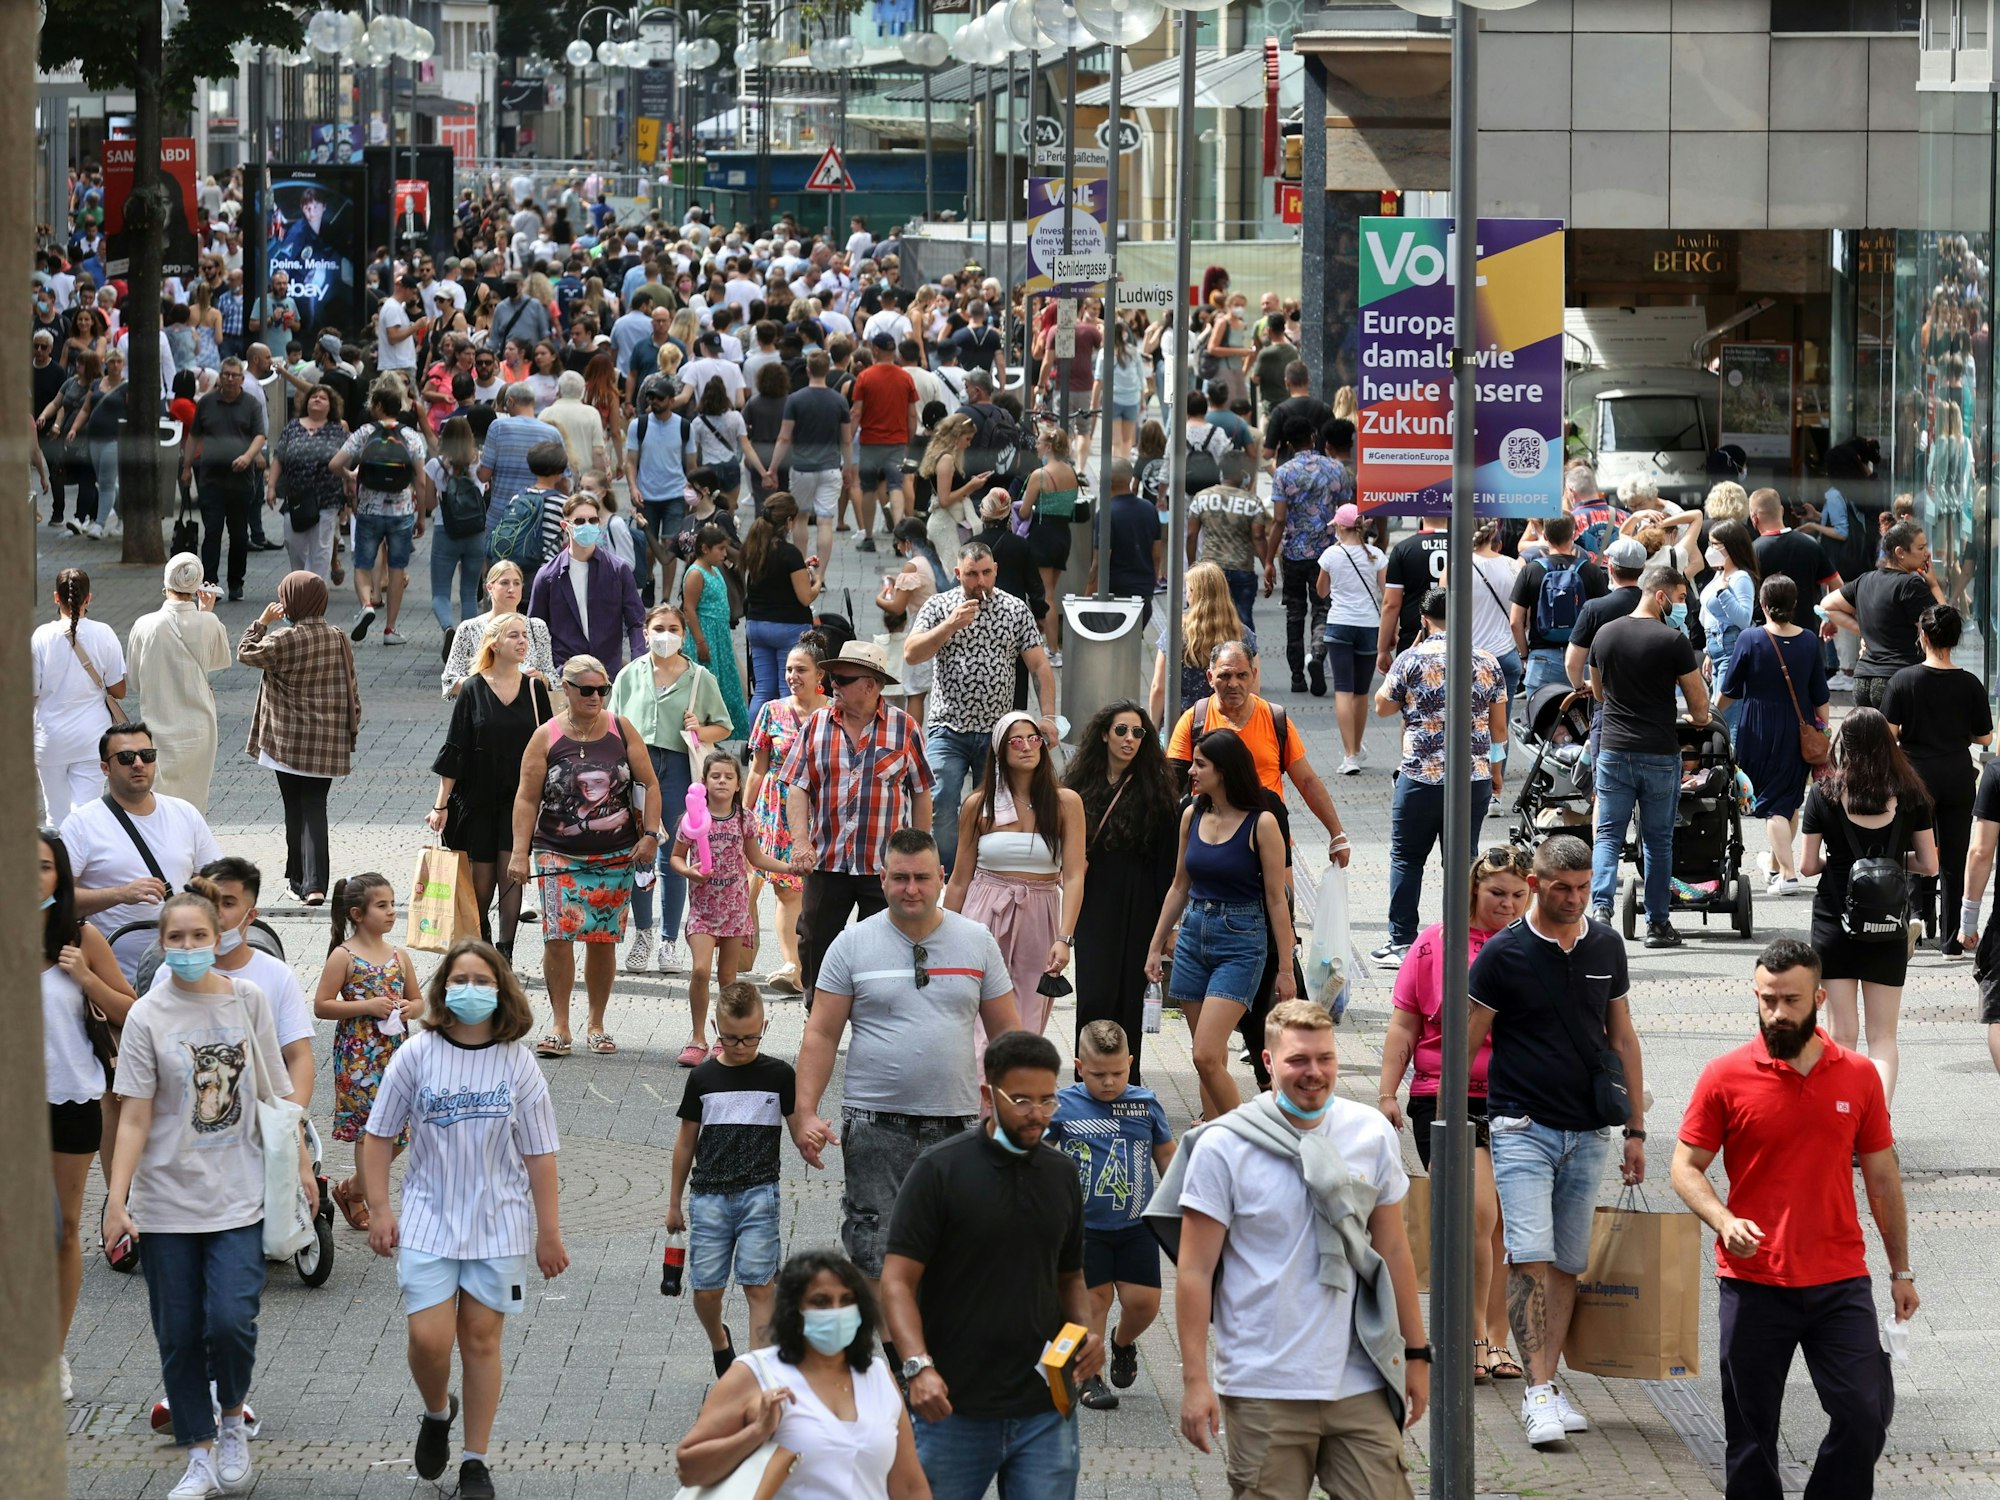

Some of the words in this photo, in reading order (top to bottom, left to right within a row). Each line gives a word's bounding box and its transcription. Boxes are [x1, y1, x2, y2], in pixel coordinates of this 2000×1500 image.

[321, 127, 352, 142] Vlt
[641, 125, 649, 134] U
[107, 150, 136, 163] SAN
[1046, 150, 1106, 164] Perlegäßchen
[1040, 227, 1088, 236] Investren
[1090, 227, 1097, 236] in
[1036, 238, 1056, 246] eine
[1056, 238, 1101, 247] Wschaft
[1042, 248, 1055, 256] mit
[162, 264, 181, 274] SPD
[270, 259, 303, 270] Deins.
[305, 259, 340, 270] Meins.
[1057, 261, 1107, 280] Schildergasse
[1118, 286, 1174, 306] Ludwigs
[1363, 311, 1455, 340] Europa
[1362, 375, 1441, 402] heute
[1450, 383, 1544, 403] nsere
[1361, 409, 1479, 436] Zukunf.
[1368, 451, 1450, 462] #GenerationEuropa
[1362, 491, 1420, 503] ZUKUNFT
[1442, 492, 1480, 503] ME
[1482, 492, 1496, 504] IN
[1498, 493, 1549, 505] EUROPE
[1863, 921, 1898, 933] PUMA
[420, 1081, 511, 1117] Originals
[1126, 1109, 1149, 1117] ABOUT?
